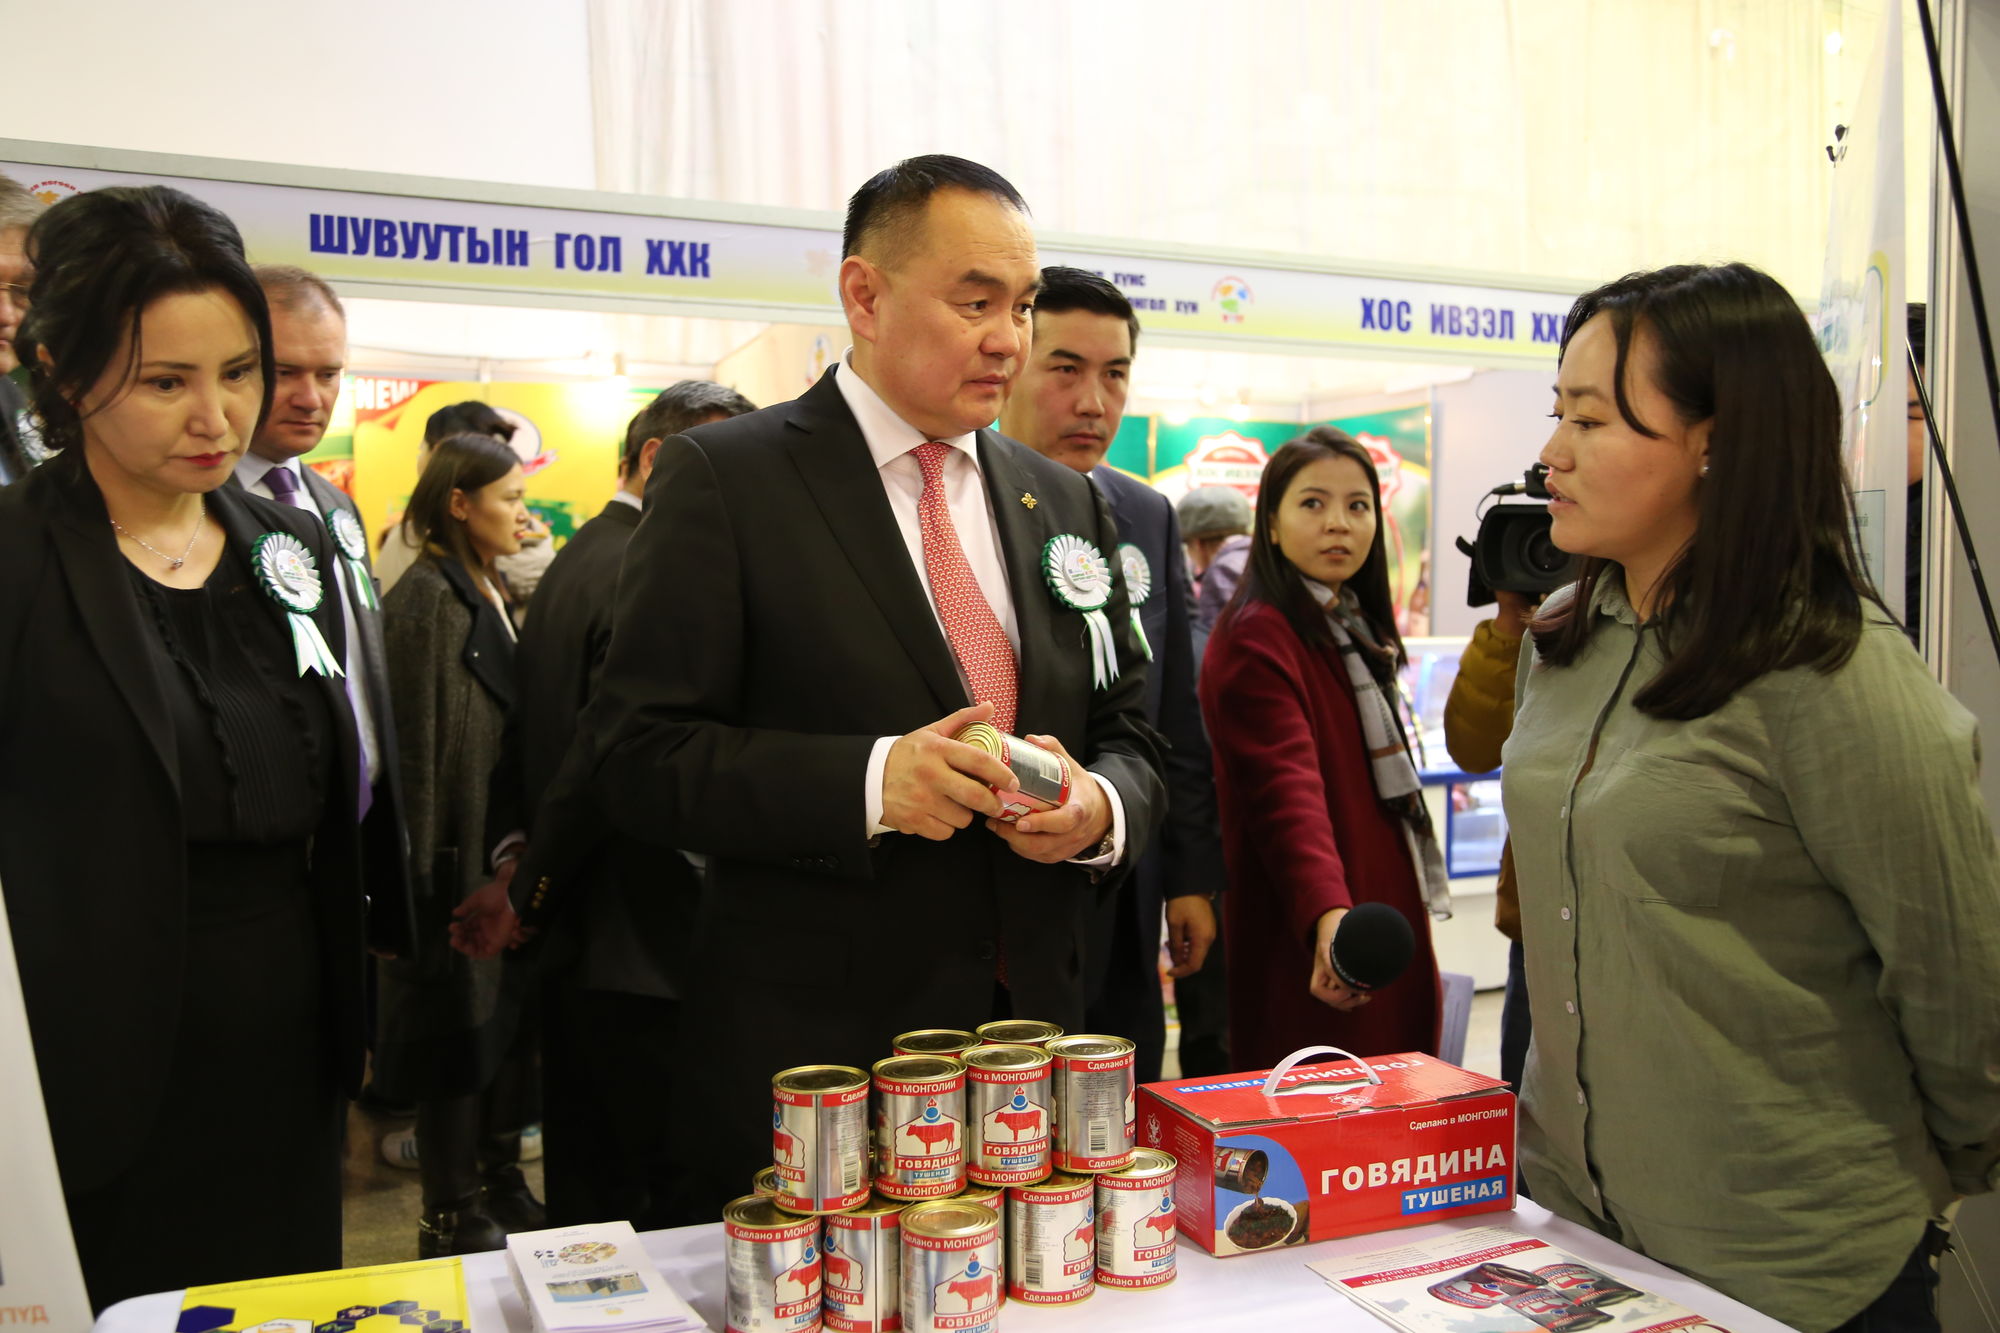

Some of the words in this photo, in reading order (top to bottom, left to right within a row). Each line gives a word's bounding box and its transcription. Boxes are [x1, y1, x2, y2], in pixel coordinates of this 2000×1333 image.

[310, 213, 529, 267] ШУВУУТЫН
[554, 232, 622, 273] ГОЛ
[645, 238, 711, 279] ХХК
[1127, 296, 1166, 311] ОНГОЛ
[1361, 297, 1412, 332] ХОС
[1430, 303, 1515, 341] ИВЭЭЛ
[355, 377, 419, 410] NEW
[1087, 1060, 1124, 1071] Сделано
[991, 1068, 1043, 1082] МОНГОЛИИ
[902, 1079, 957, 1095] МОНГОЛИИ
[773, 1089, 795, 1103] ОЛИИ
[1409, 1117, 1448, 1131] Сделано
[1457, 1107, 1508, 1124] МОНГОЛИИ
[986, 1140, 1047, 1157] ГОВЯДИНА
[898, 1152, 961, 1171] ГОВЯДИНА
[1088, 1156, 1125, 1169] Сделано
[991, 1167, 1043, 1183] МОНГОЛИИ
[1320, 1143, 1507, 1196] ГОВЯДИНА
[1097, 1175, 1133, 1188] Сделано
[903, 1182, 957, 1197] МОНГОЛИИ
[1404, 1179, 1504, 1210] ТУШЕНАЯ
[1022, 1192, 1063, 1203] Сделано
[734, 1227, 773, 1240] Сделано
[943, 1230, 995, 1249] МОНГОЛИИ
[1097, 1272, 1133, 1286] Сделано
[1023, 1291, 1063, 1303] Сделано
